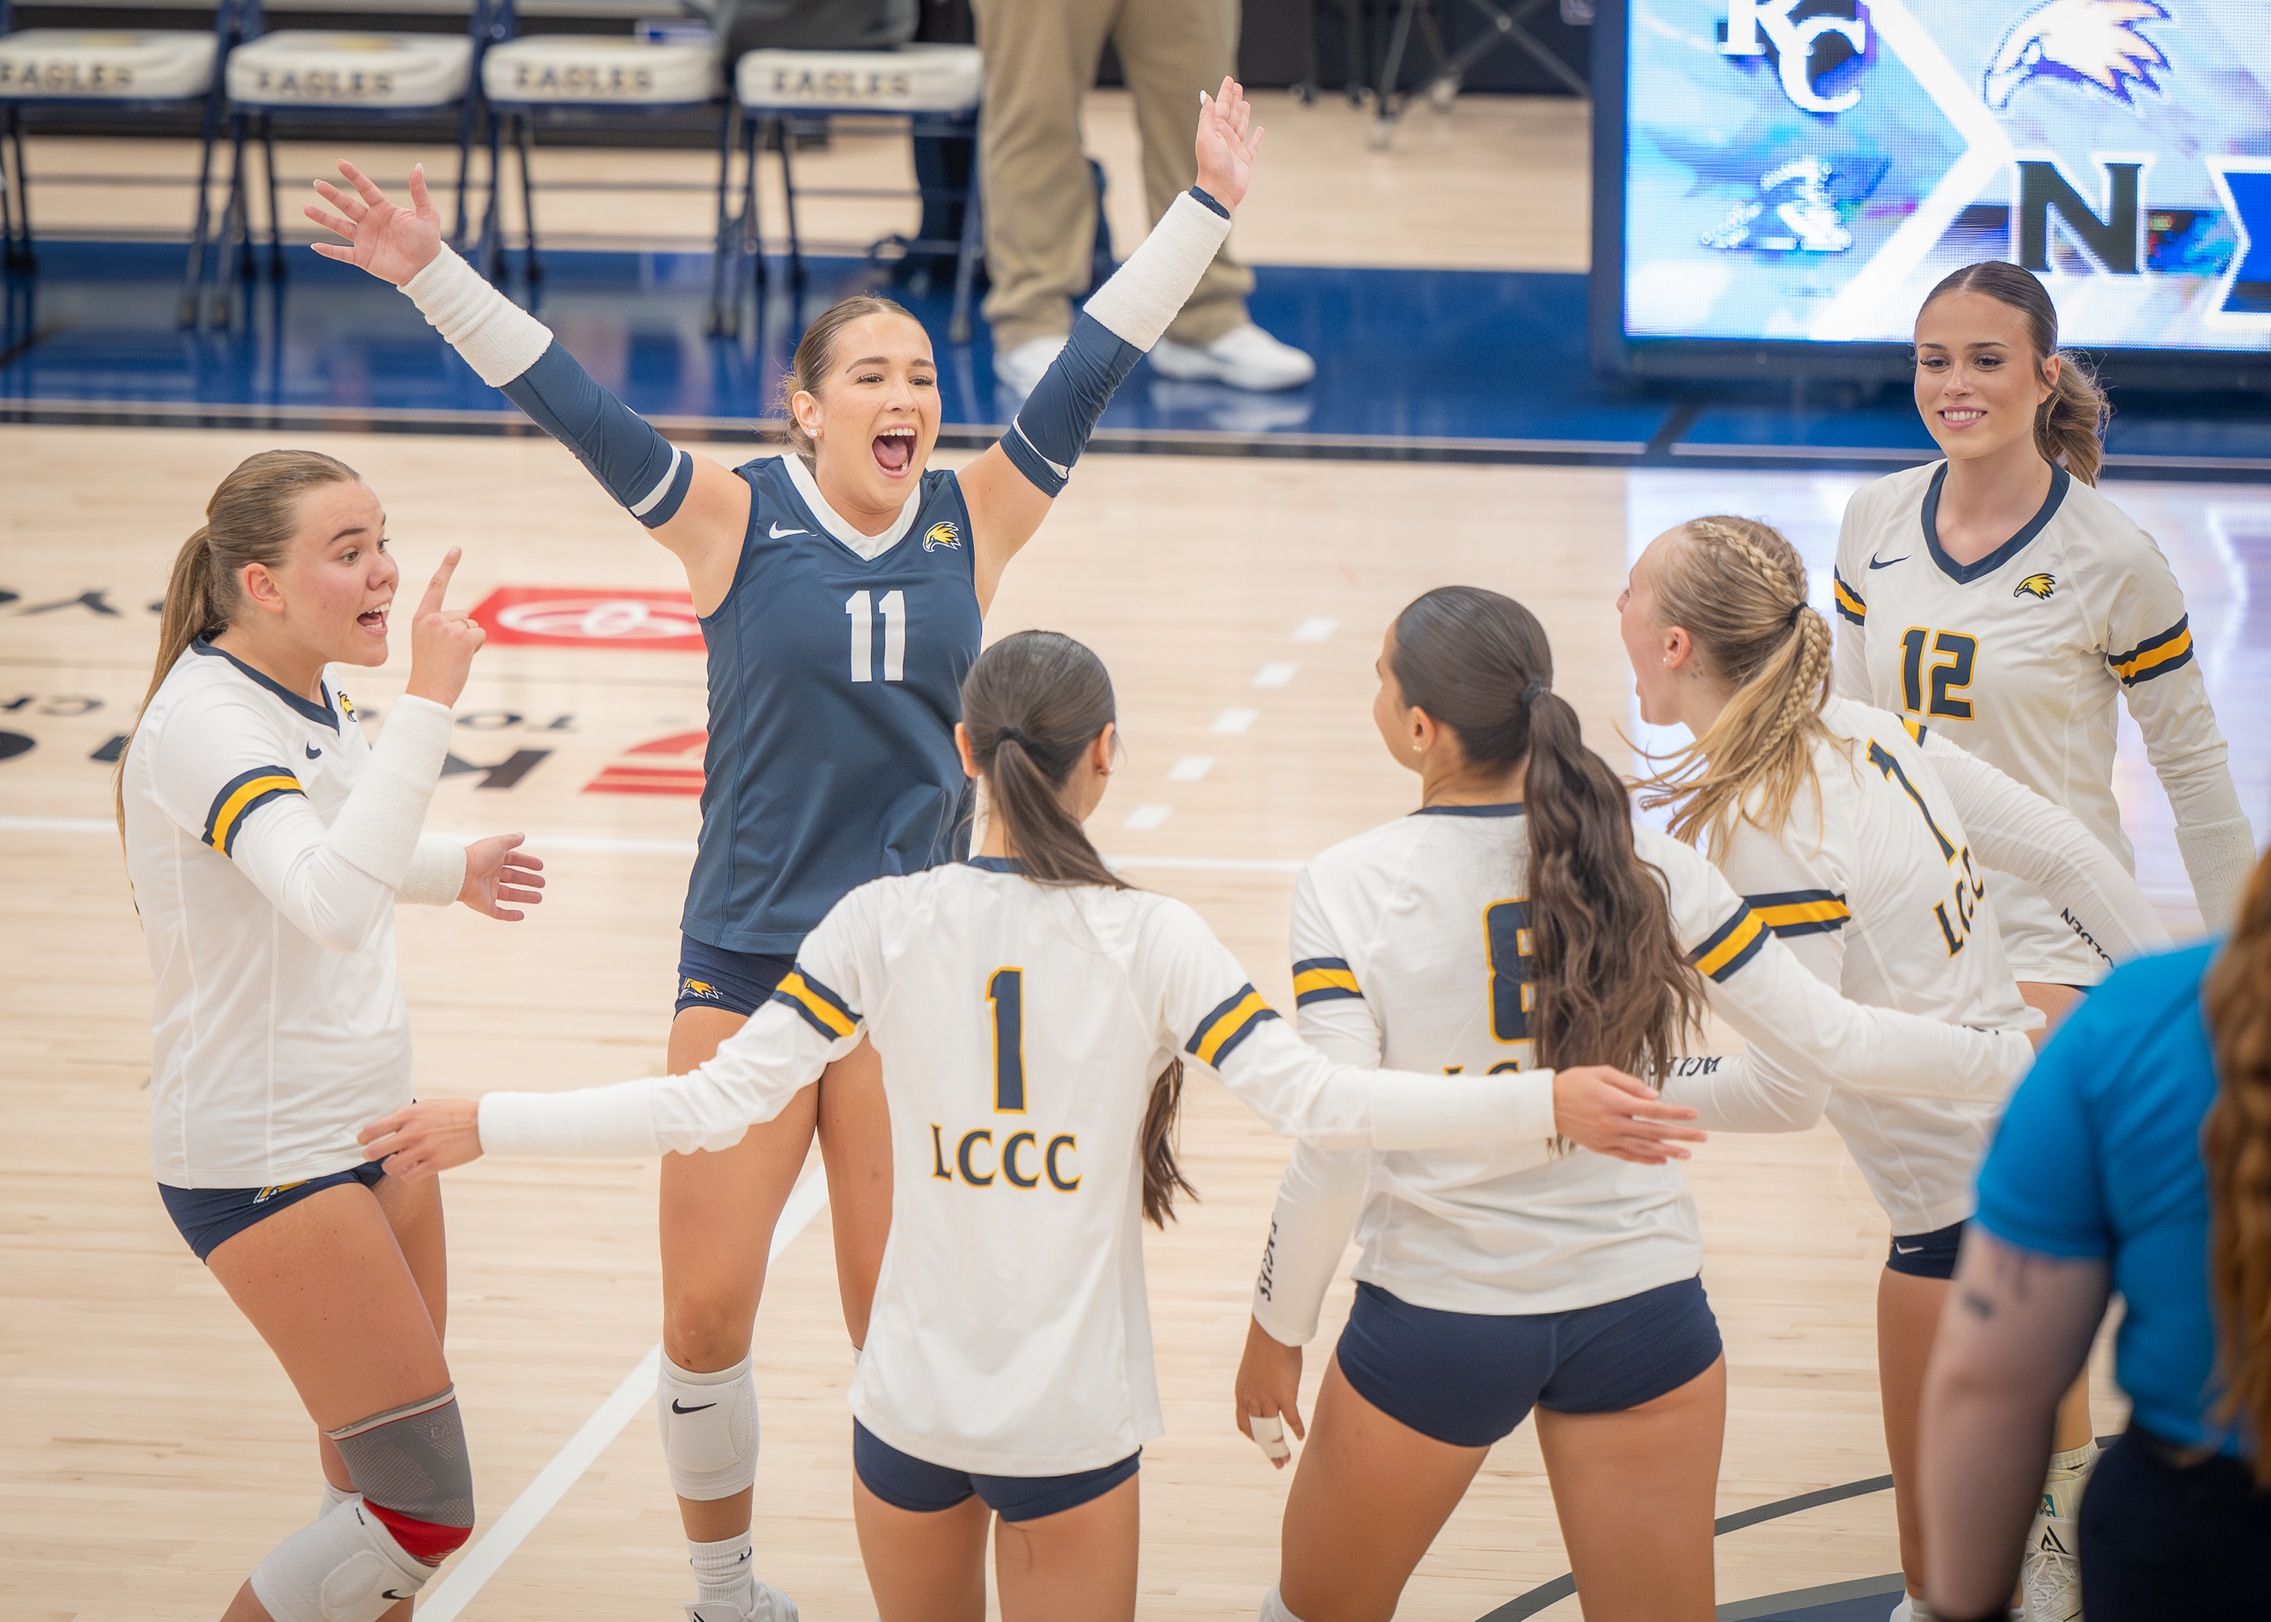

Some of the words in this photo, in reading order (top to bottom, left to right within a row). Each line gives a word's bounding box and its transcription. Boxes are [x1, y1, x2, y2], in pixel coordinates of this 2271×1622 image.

[2012, 157, 2146, 277] N
[845, 590, 906, 682] 11
[1899, 625, 1979, 721] 12
[985, 965, 1027, 1115] 1
[930, 1122, 1082, 1194] LCCC
